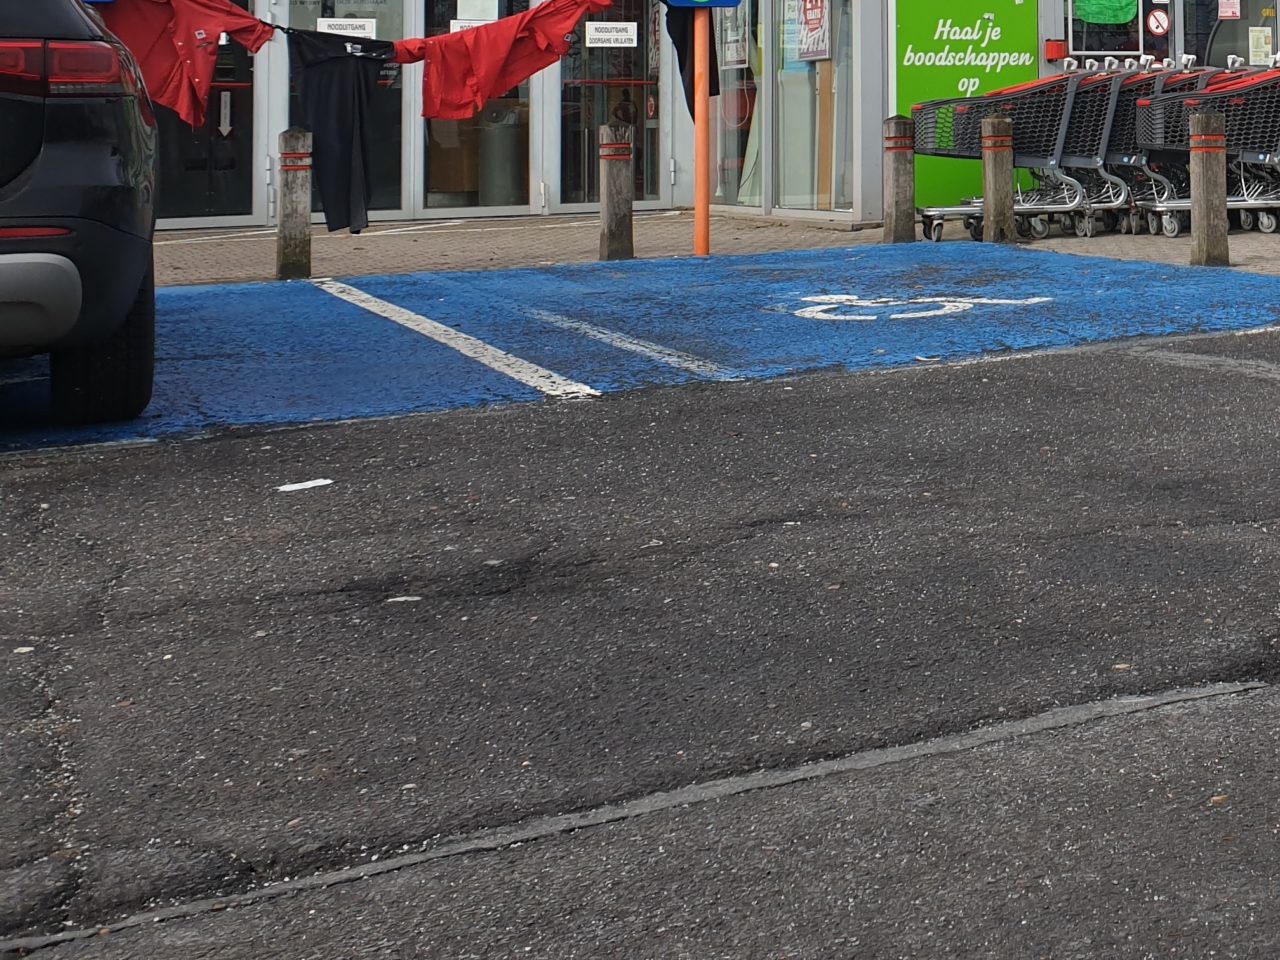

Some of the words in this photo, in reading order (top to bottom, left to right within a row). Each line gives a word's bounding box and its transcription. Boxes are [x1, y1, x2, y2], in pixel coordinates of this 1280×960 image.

[934, 19, 982, 40] Haal
[981, 19, 1001, 47] je
[903, 45, 1033, 72] boodschappen
[958, 77, 979, 97] op
